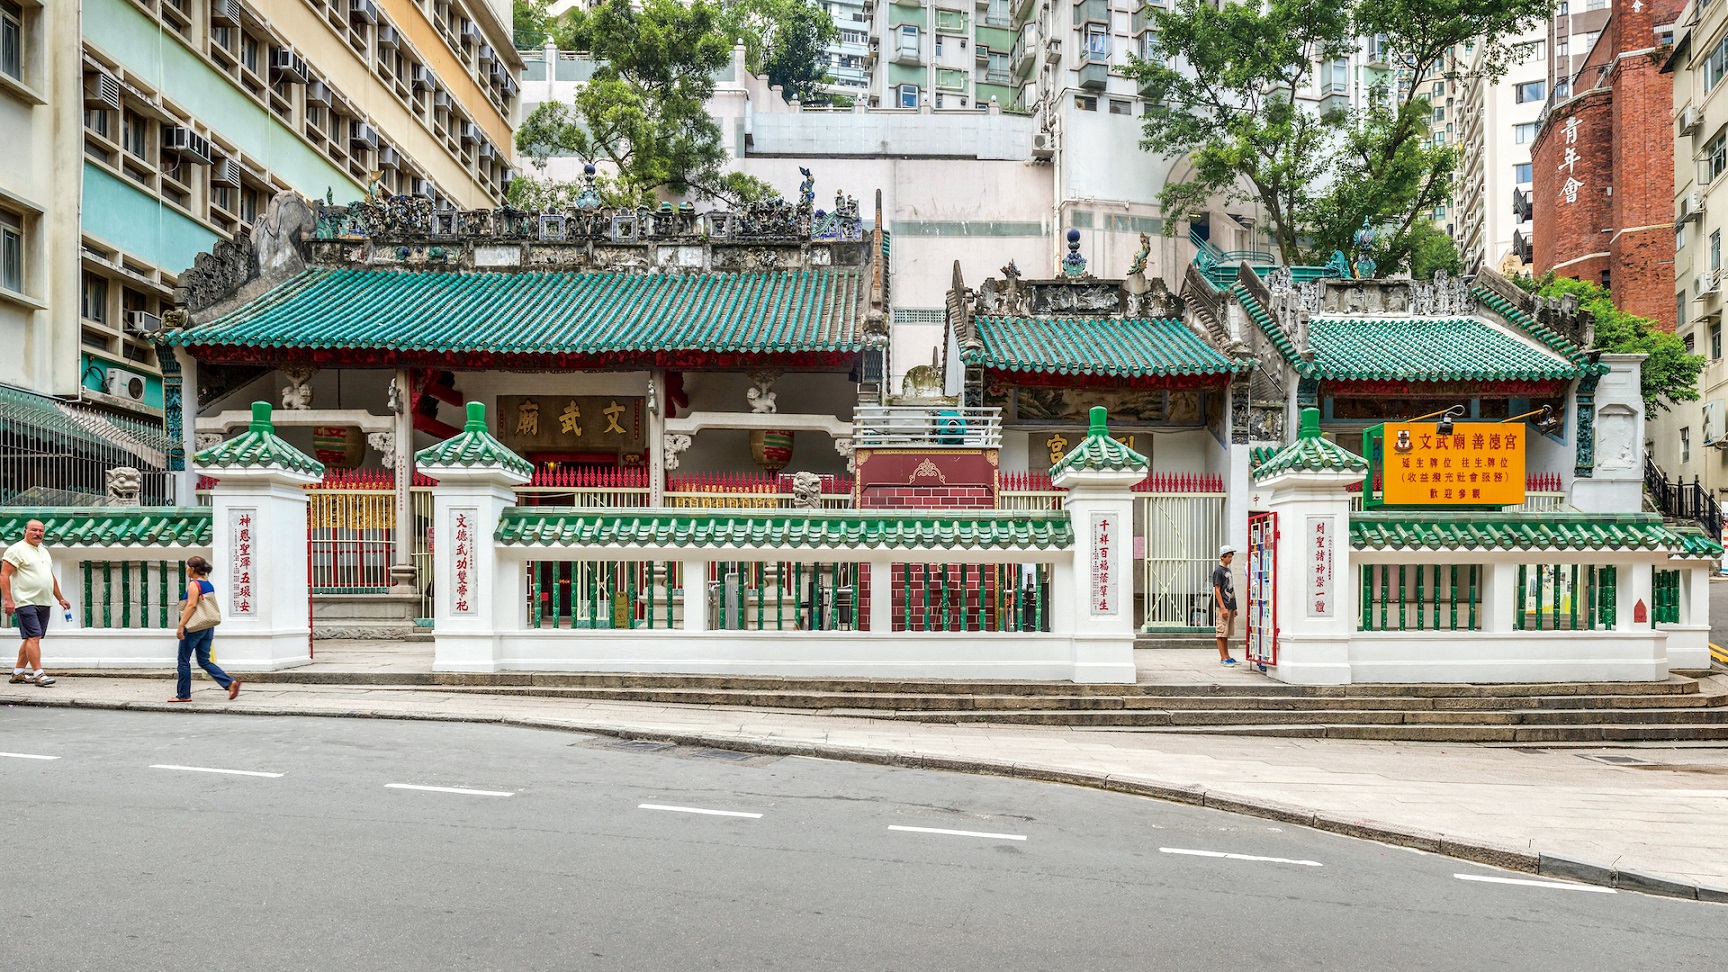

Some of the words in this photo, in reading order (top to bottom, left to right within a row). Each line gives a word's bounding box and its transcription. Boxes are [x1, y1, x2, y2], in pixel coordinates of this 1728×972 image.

[1558, 116, 1584, 203] 青年會
[514, 399, 627, 436] 文武廟
[1419, 433, 1517, 450] 文武廟善德宮
[1402, 457, 1451, 468] 延生牌位
[1430, 488, 1480, 499] 歡迎參觀
[456, 513, 468, 611] 文德武功雙帝祀
